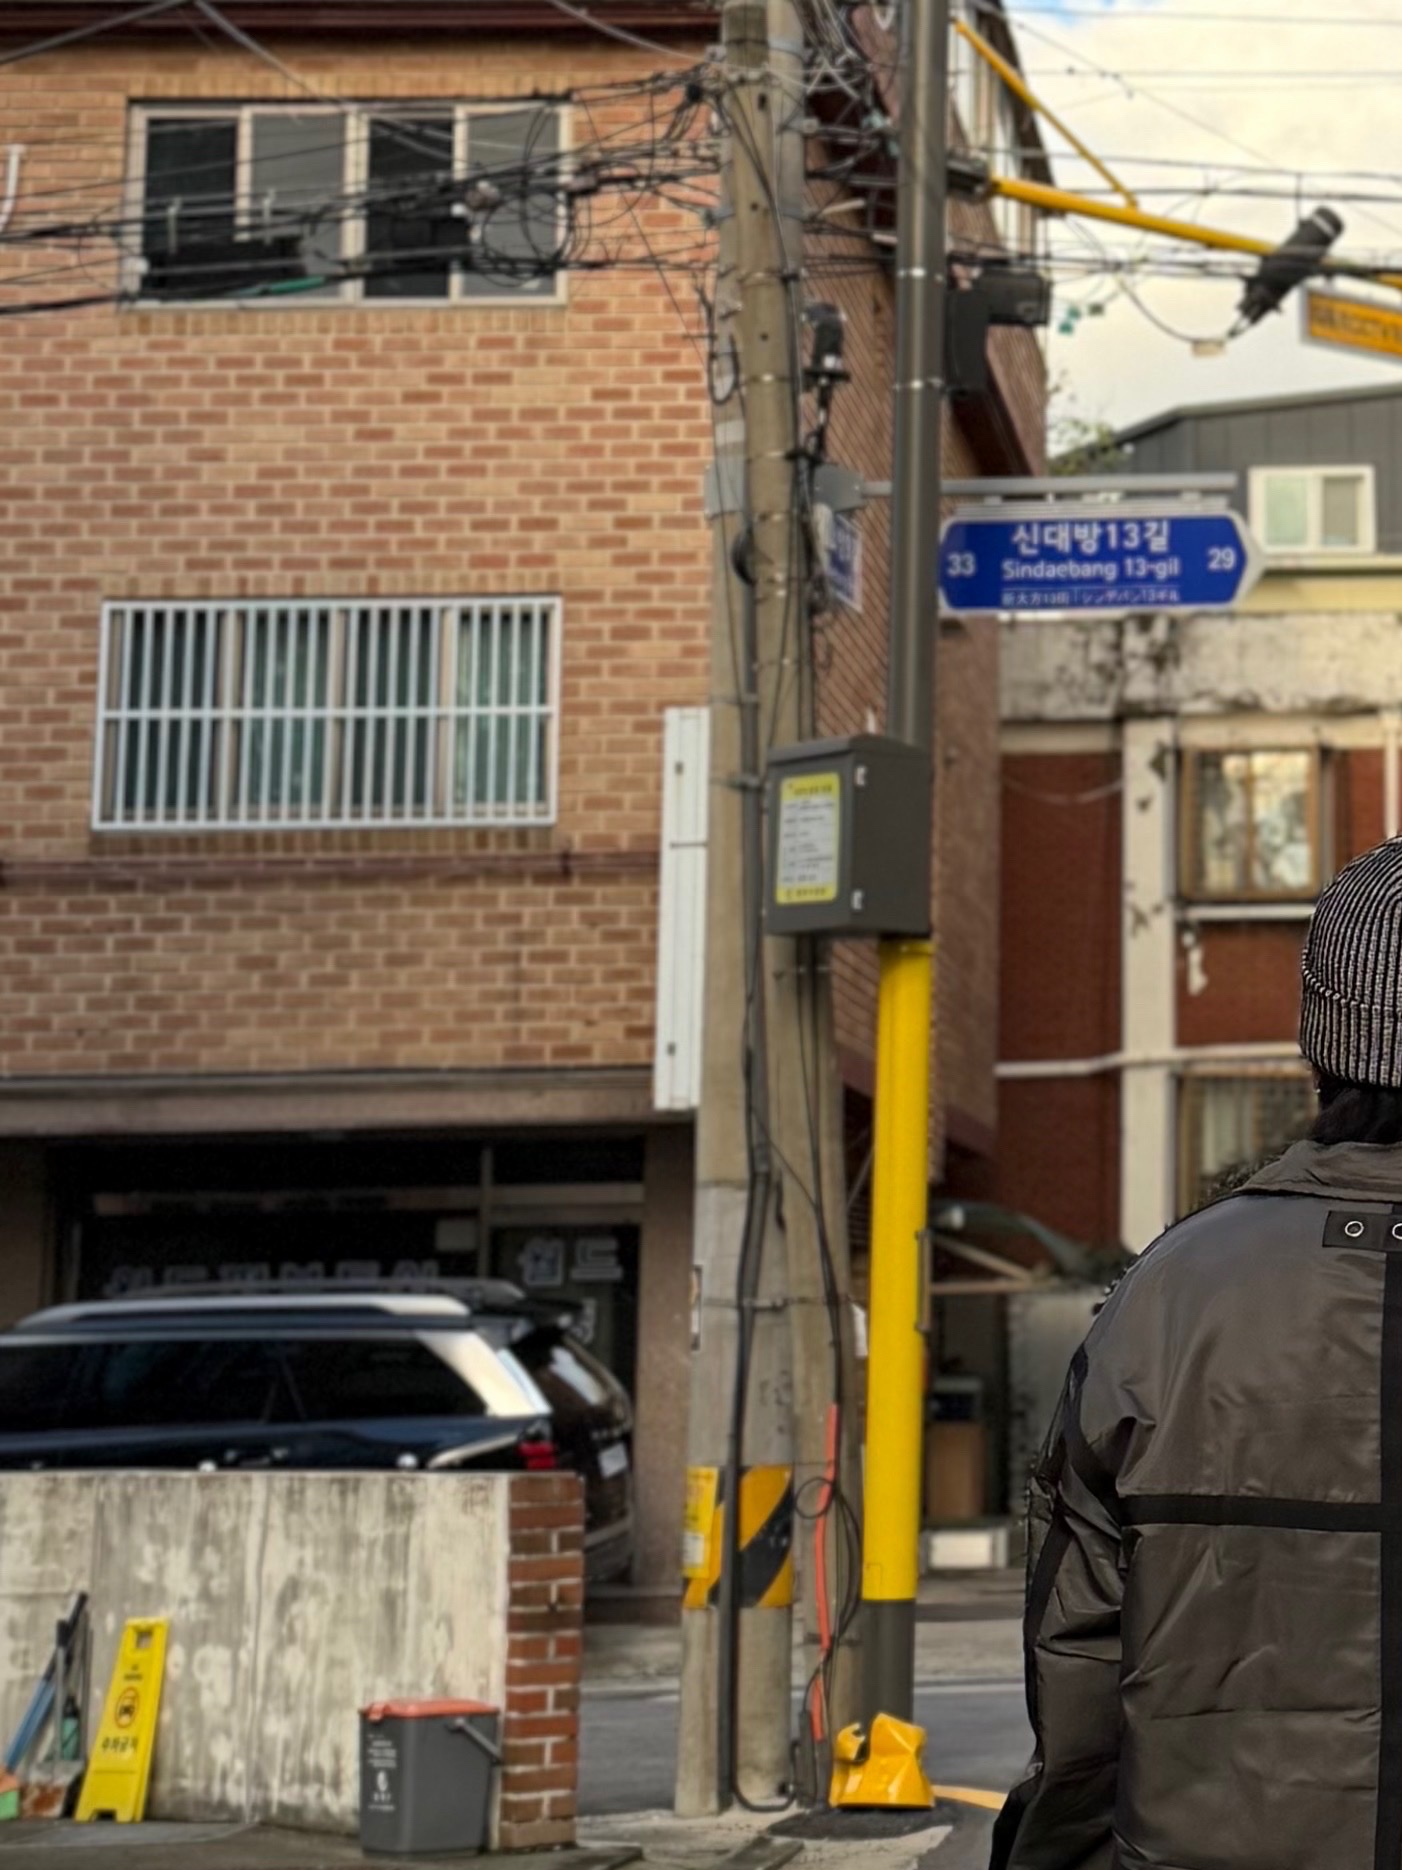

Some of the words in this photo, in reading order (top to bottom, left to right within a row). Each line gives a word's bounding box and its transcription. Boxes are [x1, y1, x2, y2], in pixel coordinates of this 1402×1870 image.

[1013, 521, 1169, 554] 신대방13길
[947, 553, 976, 577] 33
[1002, 560, 1118, 582] Sindaebang
[1125, 557, 1180, 580] 13-gil
[1208, 547, 1235, 570] 29
[519, 1237, 622, 1286] 월드
